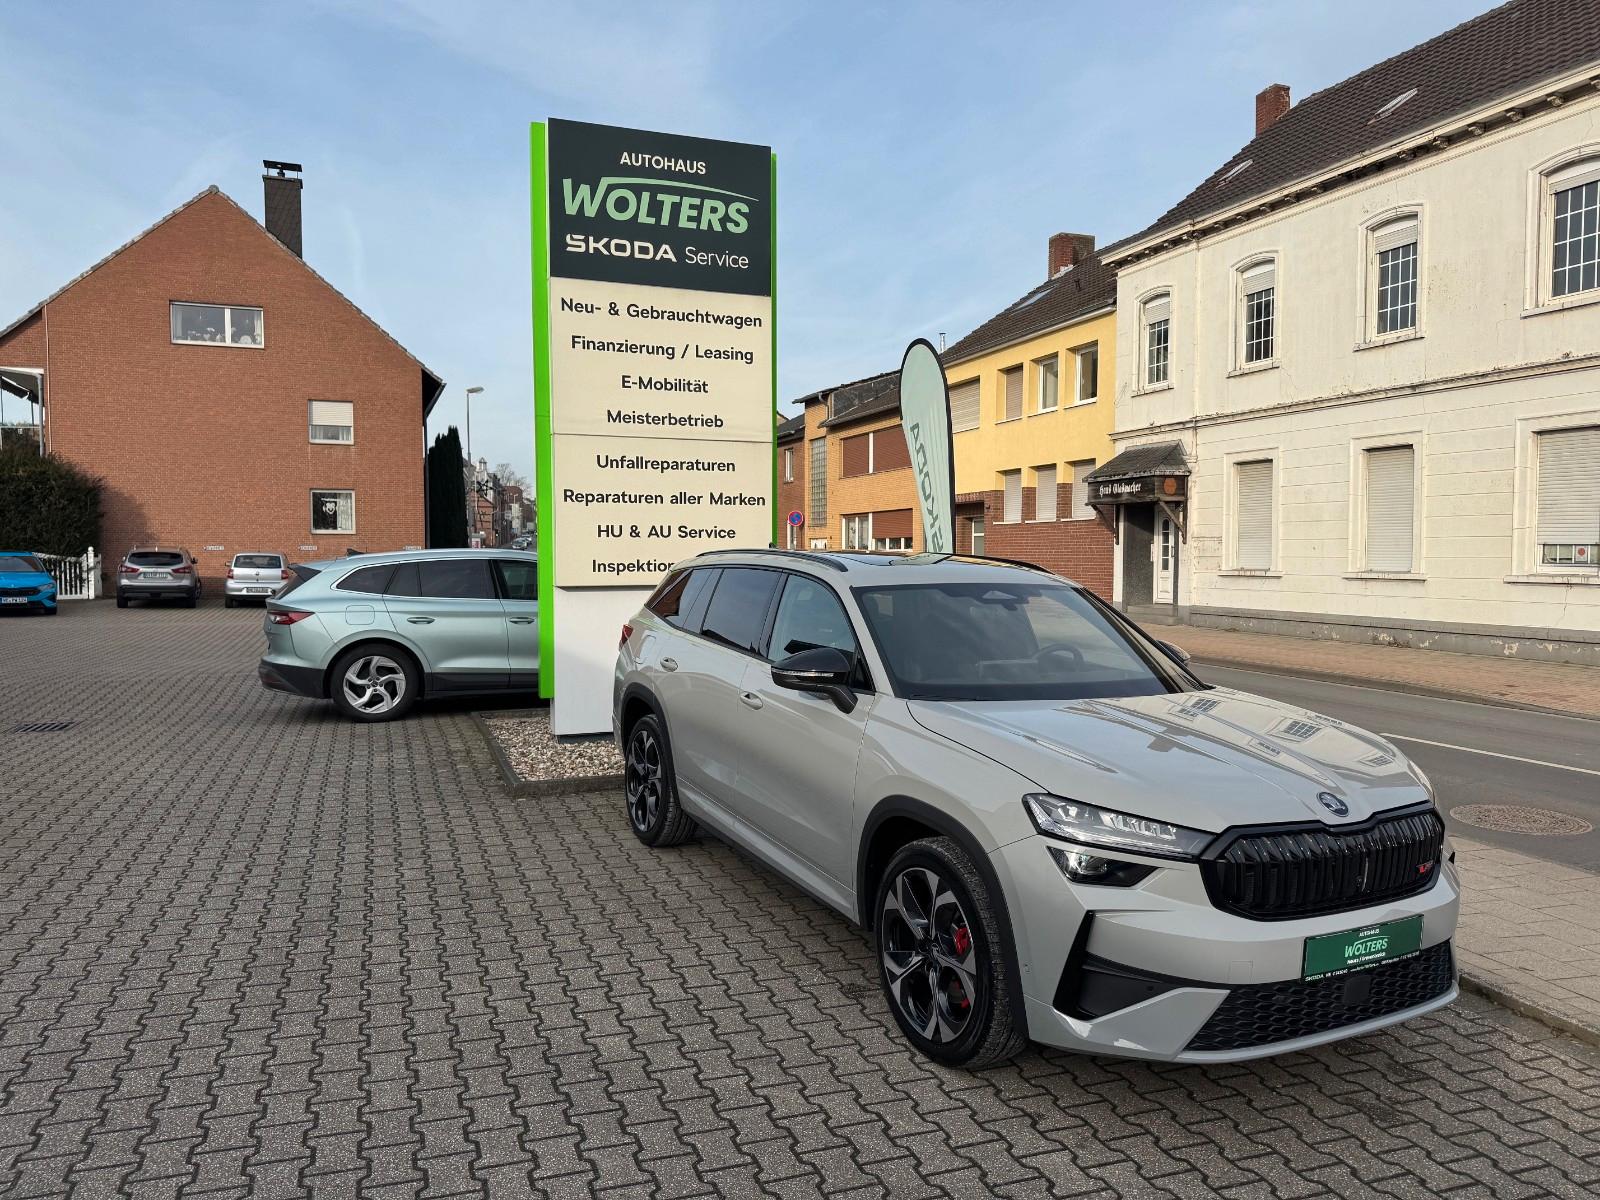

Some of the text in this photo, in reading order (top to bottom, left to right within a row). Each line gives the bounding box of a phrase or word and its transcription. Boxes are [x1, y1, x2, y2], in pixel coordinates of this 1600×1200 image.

[620, 152, 706, 174] AUTOHAUS
[562, 176, 750, 234] WOLTERS
[685, 247, 749, 269] Service
[560, 297, 762, 329] Neu- & Gebrauchtwagen
[571, 335, 754, 364] Finanzierung / Leasing
[621, 375, 709, 393] E-Mobilität
[607, 409, 724, 428] Meisterbetrieb
[596, 454, 736, 473] Unfallreparaturen
[563, 489, 766, 506] Reparaturen aller Marken
[597, 525, 737, 539] HU & AU Service
[1344, 936, 1389, 958] WOLTERS
